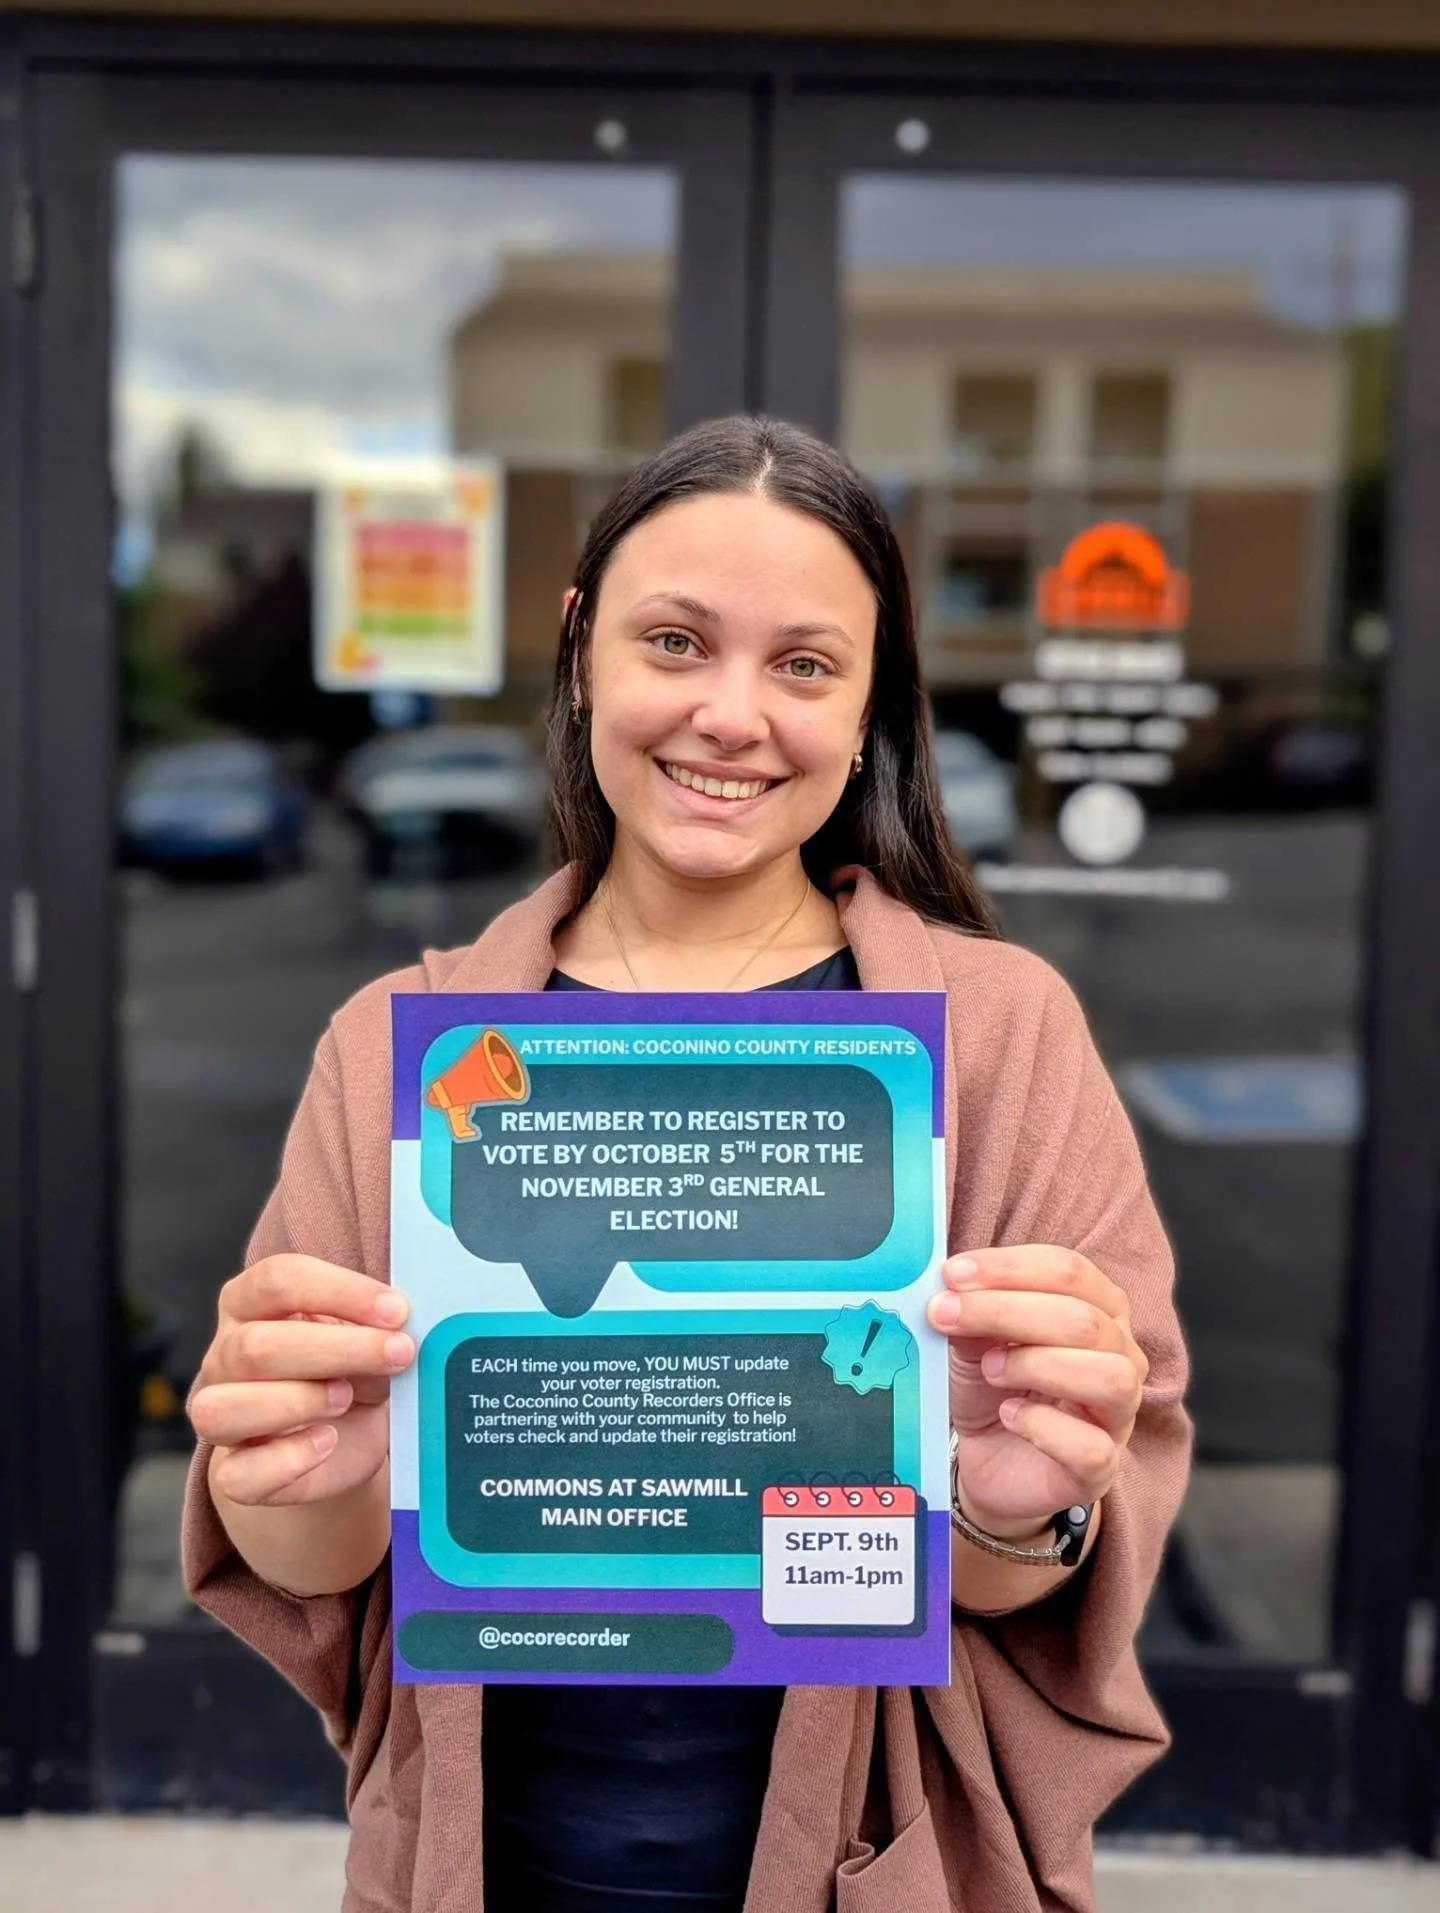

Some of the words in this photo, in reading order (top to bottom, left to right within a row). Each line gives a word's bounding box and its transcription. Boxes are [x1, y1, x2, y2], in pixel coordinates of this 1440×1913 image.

[520, 1040, 630, 1056] ATTENTION:
[633, 1040, 731, 1054] COCONINO
[735, 1040, 809, 1054] COUNTY
[814, 1040, 916, 1055] RESIDENTS
[502, 1112, 644, 1131] REMEMBER
[650, 1112, 682, 1130] TO
[688, 1111, 807, 1130] REGISTER
[813, 1111, 845, 1130] TO
[483, 1145, 548, 1164] VOTE
[554, 1145, 586, 1164] BY
[593, 1144, 709, 1164] OCTOBER
[762, 1144, 809, 1163] FOR
[815, 1144, 863, 1163] THE
[523, 1177, 662, 1197] NOVEMBER
[710, 1177, 825, 1196] GENERAL
[611, 1210, 737, 1230] ELECTION!
[472, 1359, 517, 1372] EACH
[522, 1358, 557, 1372] time
[561, 1361, 589, 1375] you
[594, 1361, 640, 1375] move,
[645, 1357, 678, 1371] YOU
[684, 1357, 731, 1370] MUST
[735, 1357, 789, 1373] update
[541, 1380, 576, 1392] your
[580, 1376, 622, 1390] voter
[626, 1375, 720, 1392] registration.
[469, 1395, 500, 1408] The
[504, 1393, 578, 1408] Coconino
[582, 1394, 639, 1411] County
[643, 1392, 723, 1407] Recorders
[728, 1392, 775, 1406] Office
[779, 1392, 791, 1406] is
[475, 1412, 558, 1429] partnering
[561, 1412, 595, 1425] with
[598, 1415, 634, 1429] your
[638, 1411, 726, 1429] community
[733, 1411, 749, 1424] to
[754, 1410, 786, 1429] help
[465, 1430, 514, 1443] voters
[518, 1428, 565, 1443] check
[569, 1428, 598, 1443] and
[602, 1428, 656, 1444] update
[660, 1429, 697, 1442] their
[701, 1427, 796, 1444] registration!
[481, 1479, 603, 1496] COMMONS
[608, 1479, 636, 1496] AT
[642, 1479, 748, 1496] SAWMILL
[542, 1508, 601, 1525] MAIN
[607, 1508, 687, 1526] OFFICE
[786, 1532, 851, 1551] SEPT.
[859, 1533, 898, 1551] 9th
[786, 1566, 902, 1587] 11am-1pm
[479, 1628, 630, 1649] @cocorecorder
